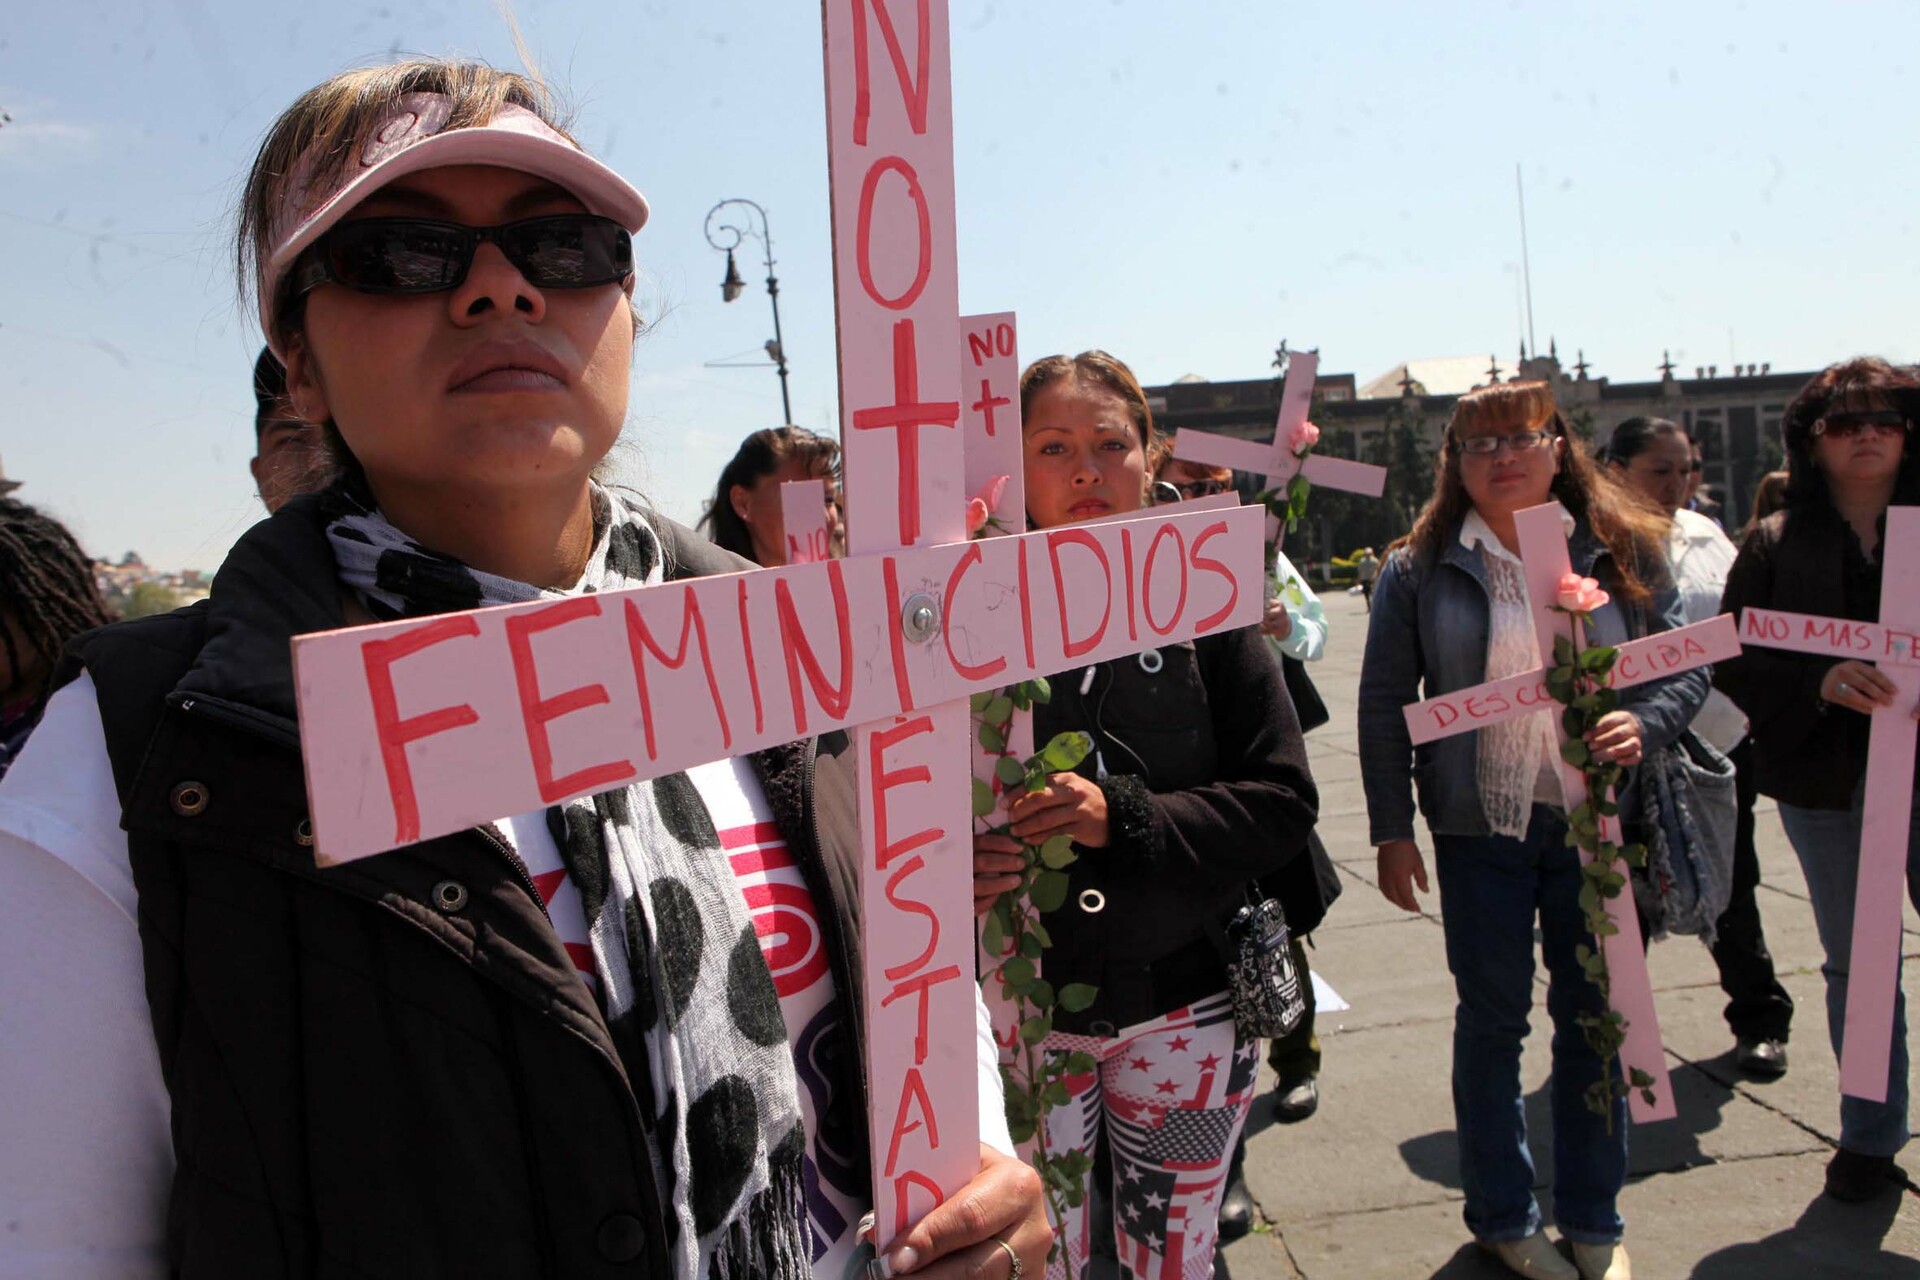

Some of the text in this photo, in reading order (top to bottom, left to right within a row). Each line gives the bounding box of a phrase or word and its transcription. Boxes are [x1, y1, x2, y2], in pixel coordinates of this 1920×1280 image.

[850, 0, 932, 310] NO
[968, 323, 1014, 366] NO
[1748, 610, 1789, 641] NO
[1803, 619, 1871, 651] MAS
[361, 520, 1239, 844] FEMINICIDIOS
[1428, 637, 1705, 729] DESCOCIDA
